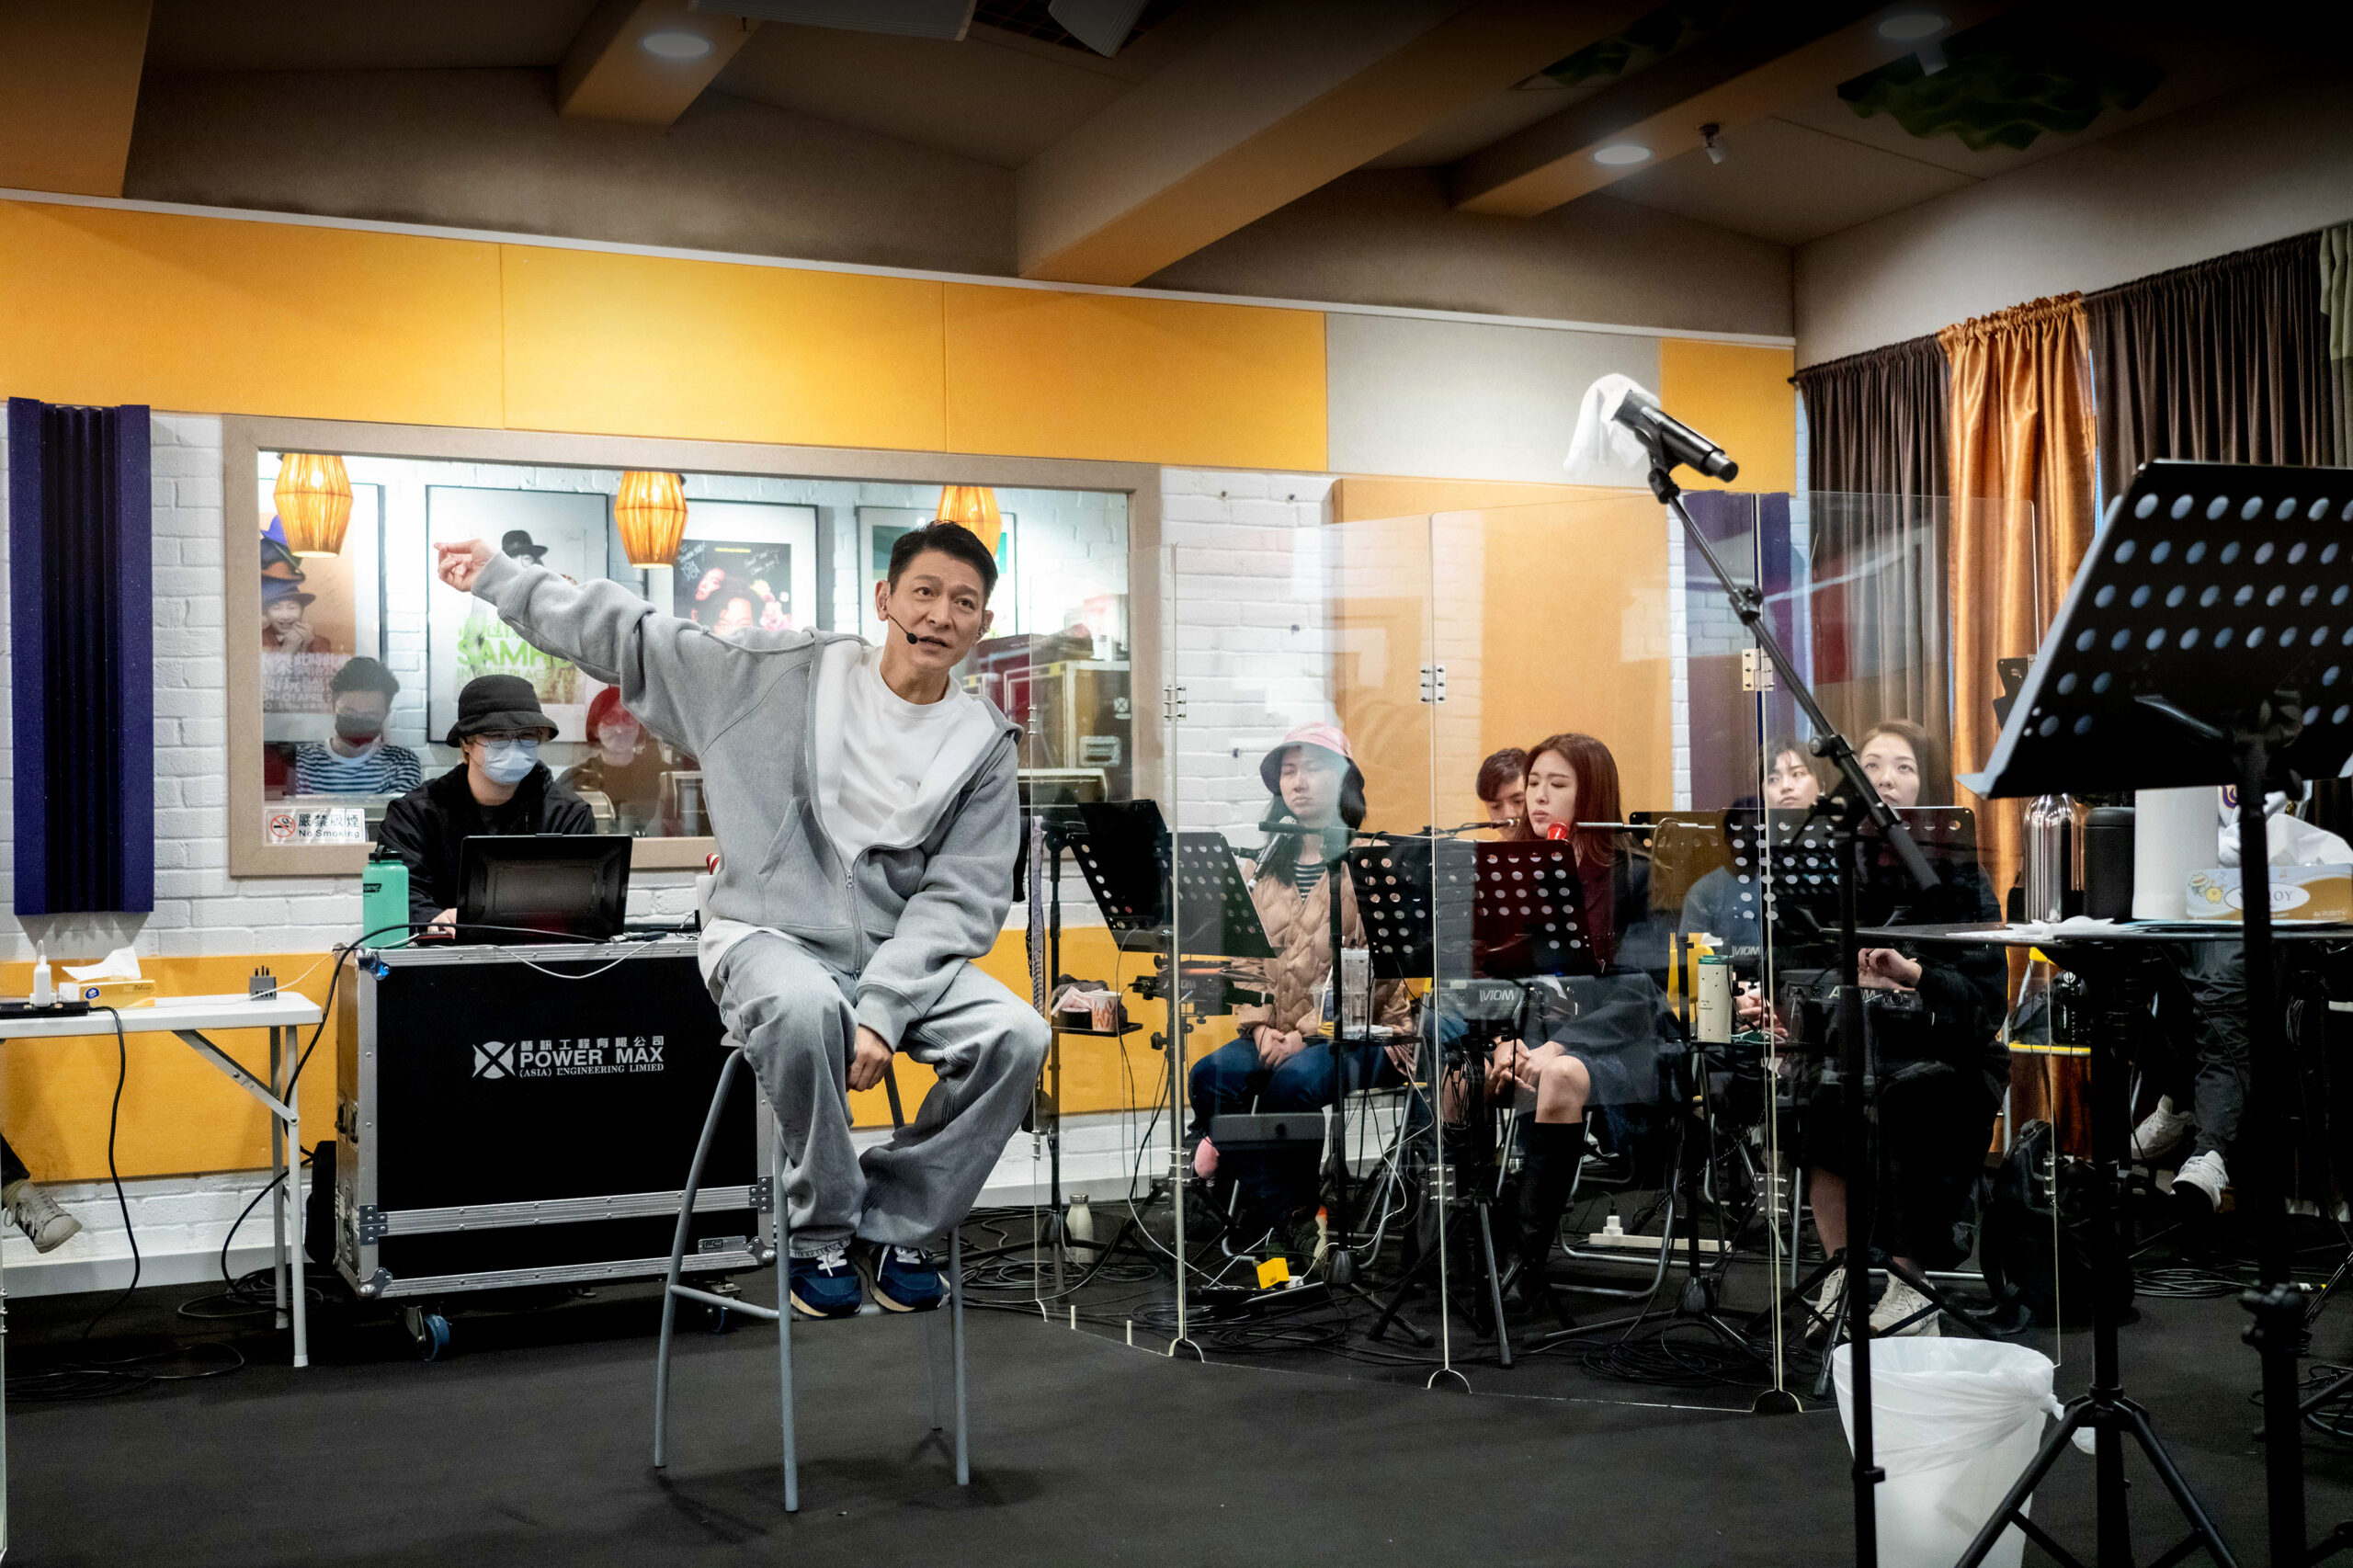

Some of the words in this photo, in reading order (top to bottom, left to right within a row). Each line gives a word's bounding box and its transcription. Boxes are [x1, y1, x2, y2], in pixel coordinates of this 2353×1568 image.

[299, 813, 359, 827] 嚴禁吸煙
[315, 830, 360, 838] Smoking
[519, 1049, 603, 1068] POWER
[616, 1046, 664, 1064] MAX
[519, 1069, 552, 1078] (ASIA)
[556, 1064, 625, 1076] ENGINEERING
[629, 1062, 665, 1073] LIMIED
